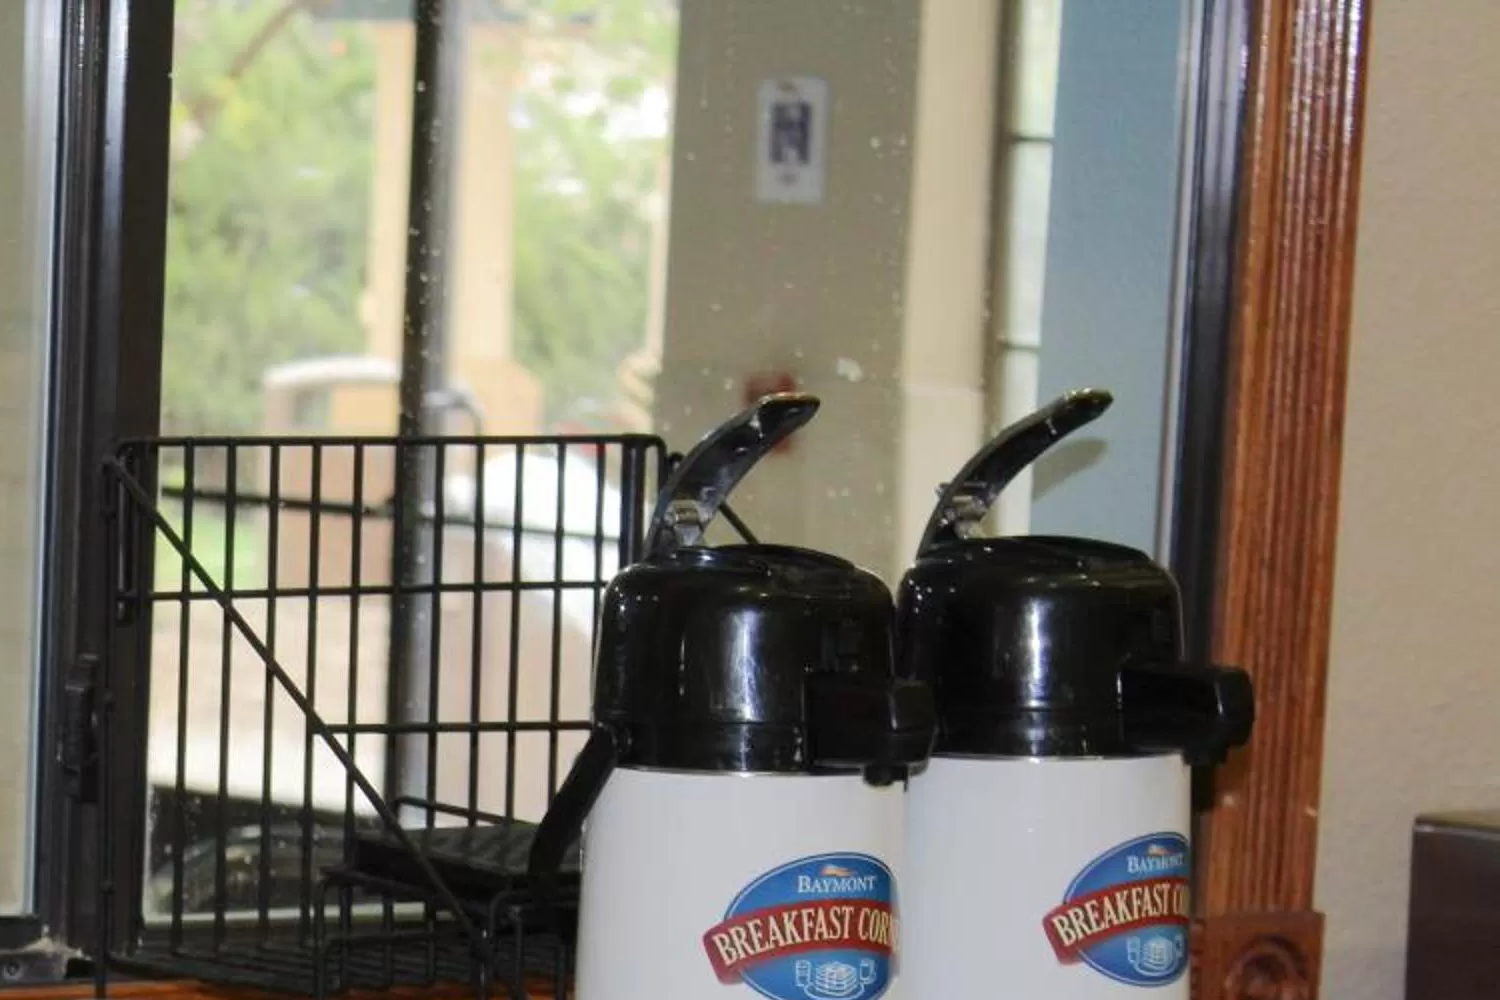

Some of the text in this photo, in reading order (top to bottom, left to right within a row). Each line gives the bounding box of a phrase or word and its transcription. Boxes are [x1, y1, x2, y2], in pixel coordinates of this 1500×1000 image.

[797, 875, 877, 893] BAYMONT
[712, 906, 854, 966] BREAKFAST
[1052, 883, 1172, 947] BREAKFAST
